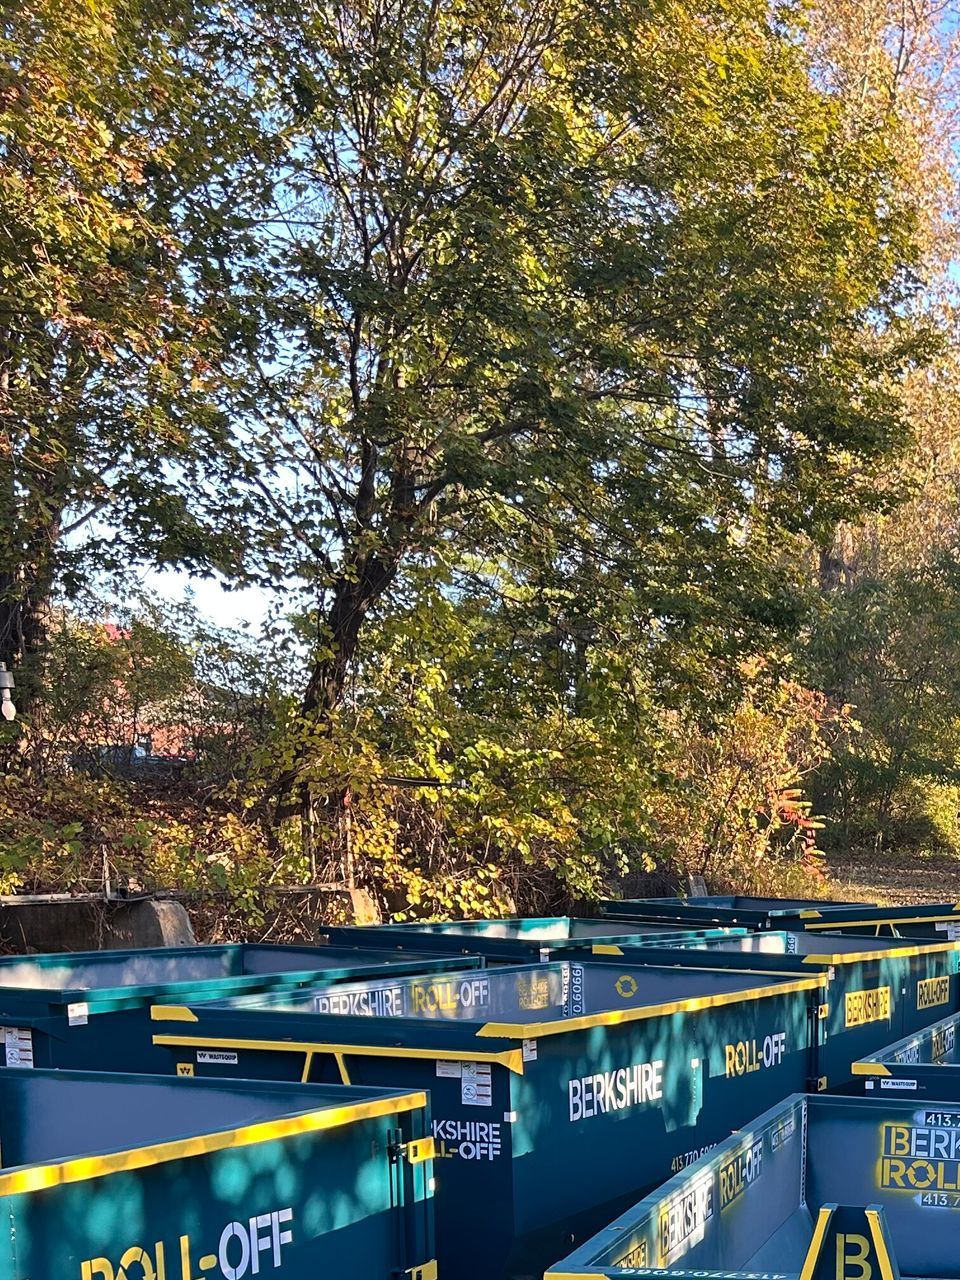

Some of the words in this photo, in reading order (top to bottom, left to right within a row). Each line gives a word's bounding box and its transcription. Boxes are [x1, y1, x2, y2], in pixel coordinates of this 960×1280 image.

[413, 978, 489, 1014] ROLL-OFF
[846, 988, 890, 1023] BERKSHIRE
[918, 979, 949, 1006] ROLL-OFF
[567, 1059, 664, 1122] BERKSHIRE
[725, 1032, 786, 1078] ROLL-OFF
[720, 1144, 763, 1207] ROLL-OFF
